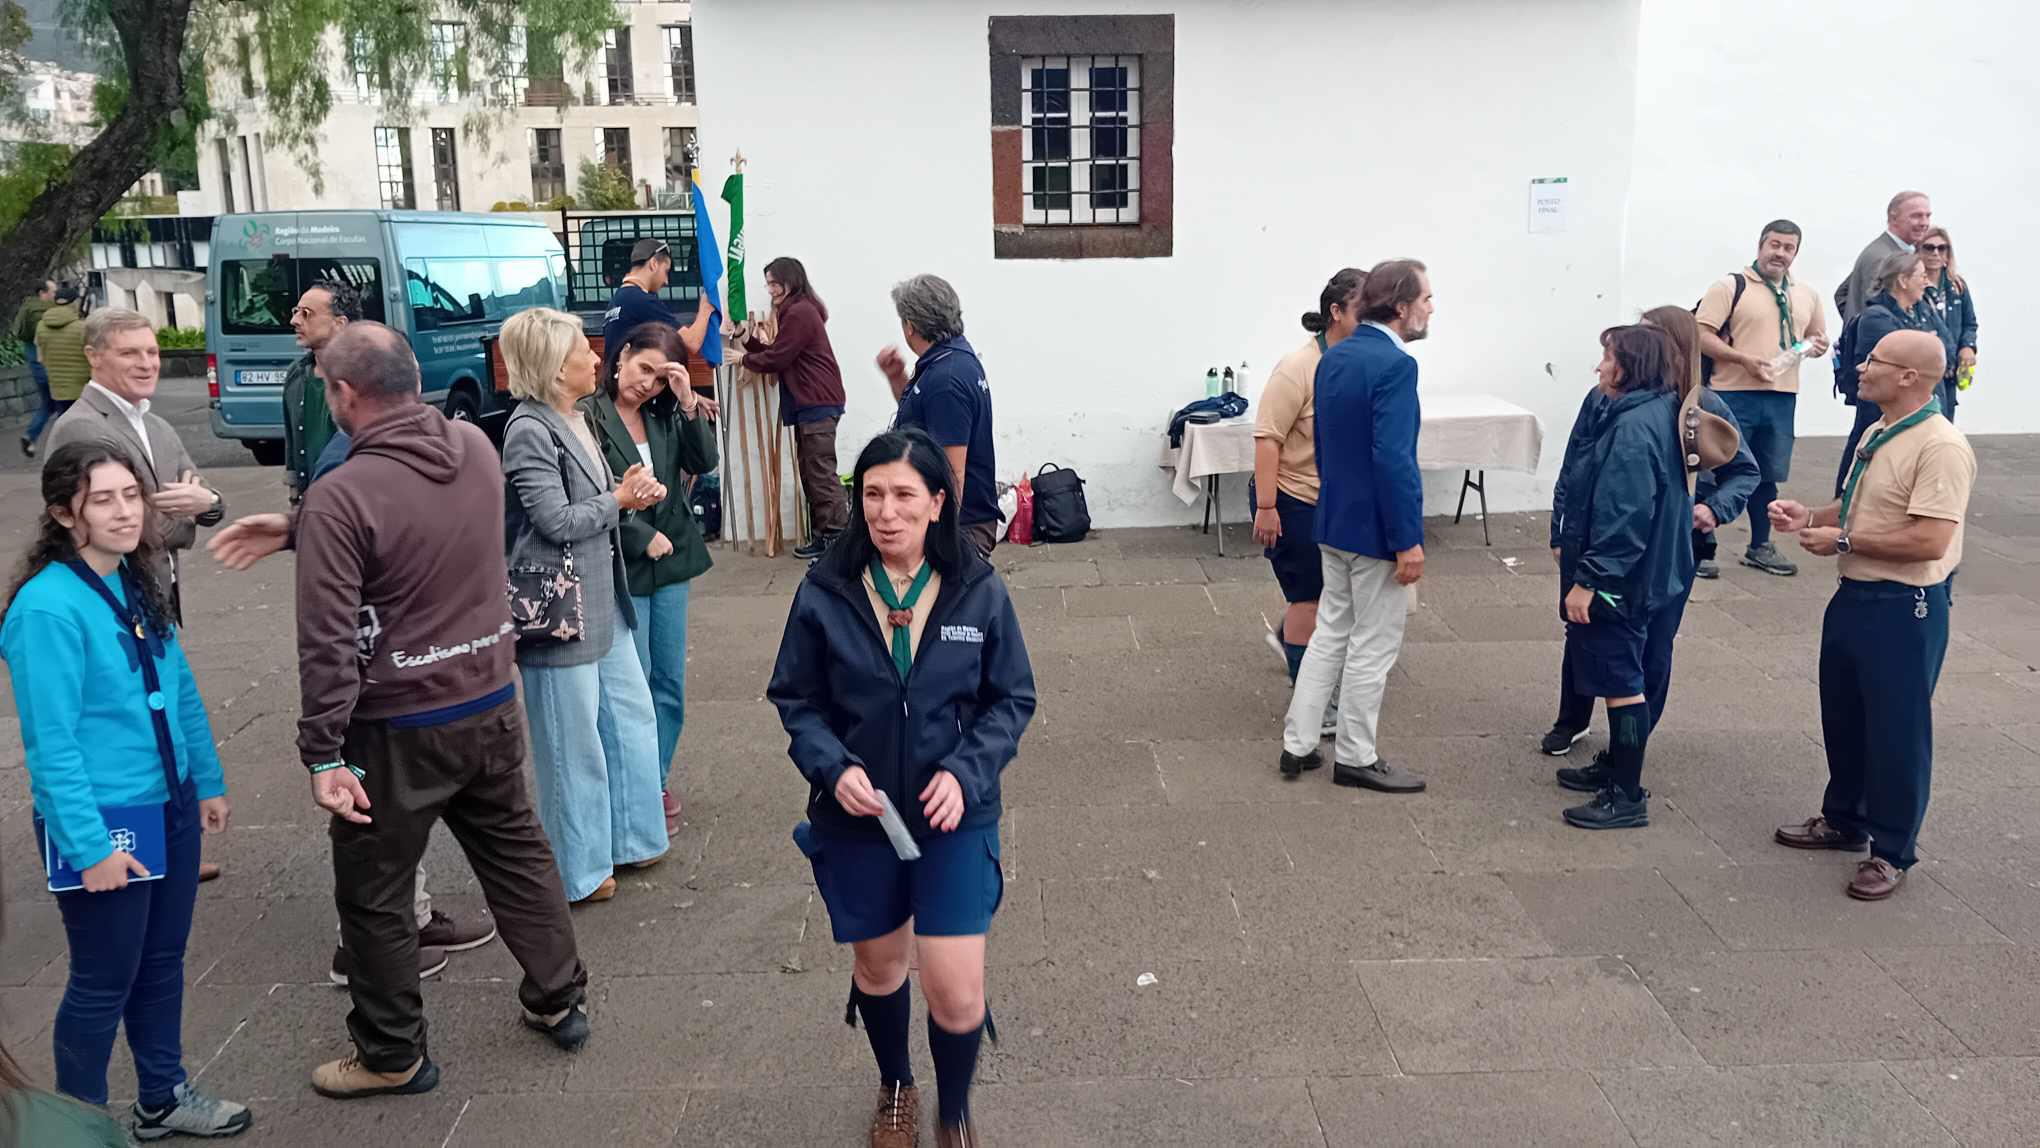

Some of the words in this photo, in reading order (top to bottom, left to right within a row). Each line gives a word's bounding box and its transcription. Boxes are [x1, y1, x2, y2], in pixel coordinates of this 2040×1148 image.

[310, 225, 340, 234] Madeira
[257, 372, 271, 382] HV
[390, 643, 471, 669] Escotismo
